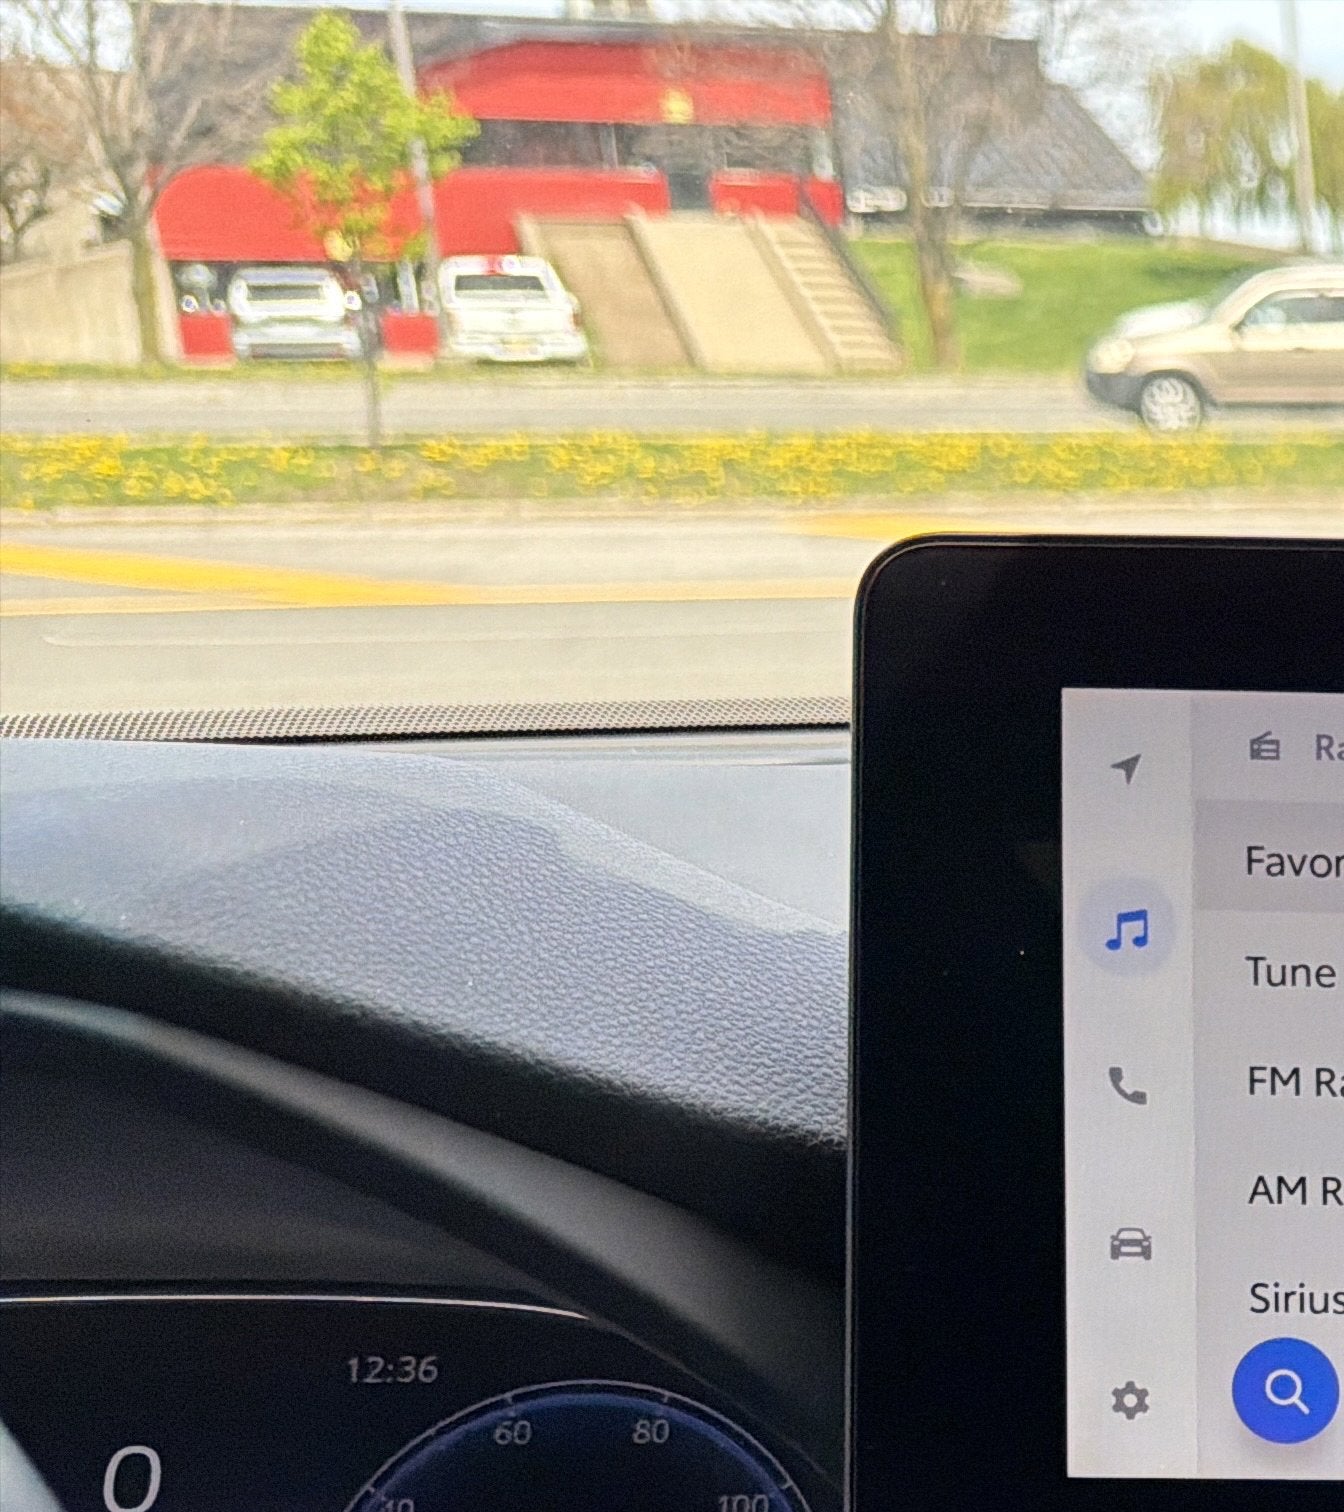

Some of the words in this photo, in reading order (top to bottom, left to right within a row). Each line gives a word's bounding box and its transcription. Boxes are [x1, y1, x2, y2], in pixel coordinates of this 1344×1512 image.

[1245, 956, 1337, 988] Tune
[1248, 1066, 1301, 1097] FM
[1248, 1175, 1308, 1206] AM
[347, 1356, 439, 1384] 12:36
[493, 1420, 532, 1445] 60
[632, 1419, 670, 1445] 80
